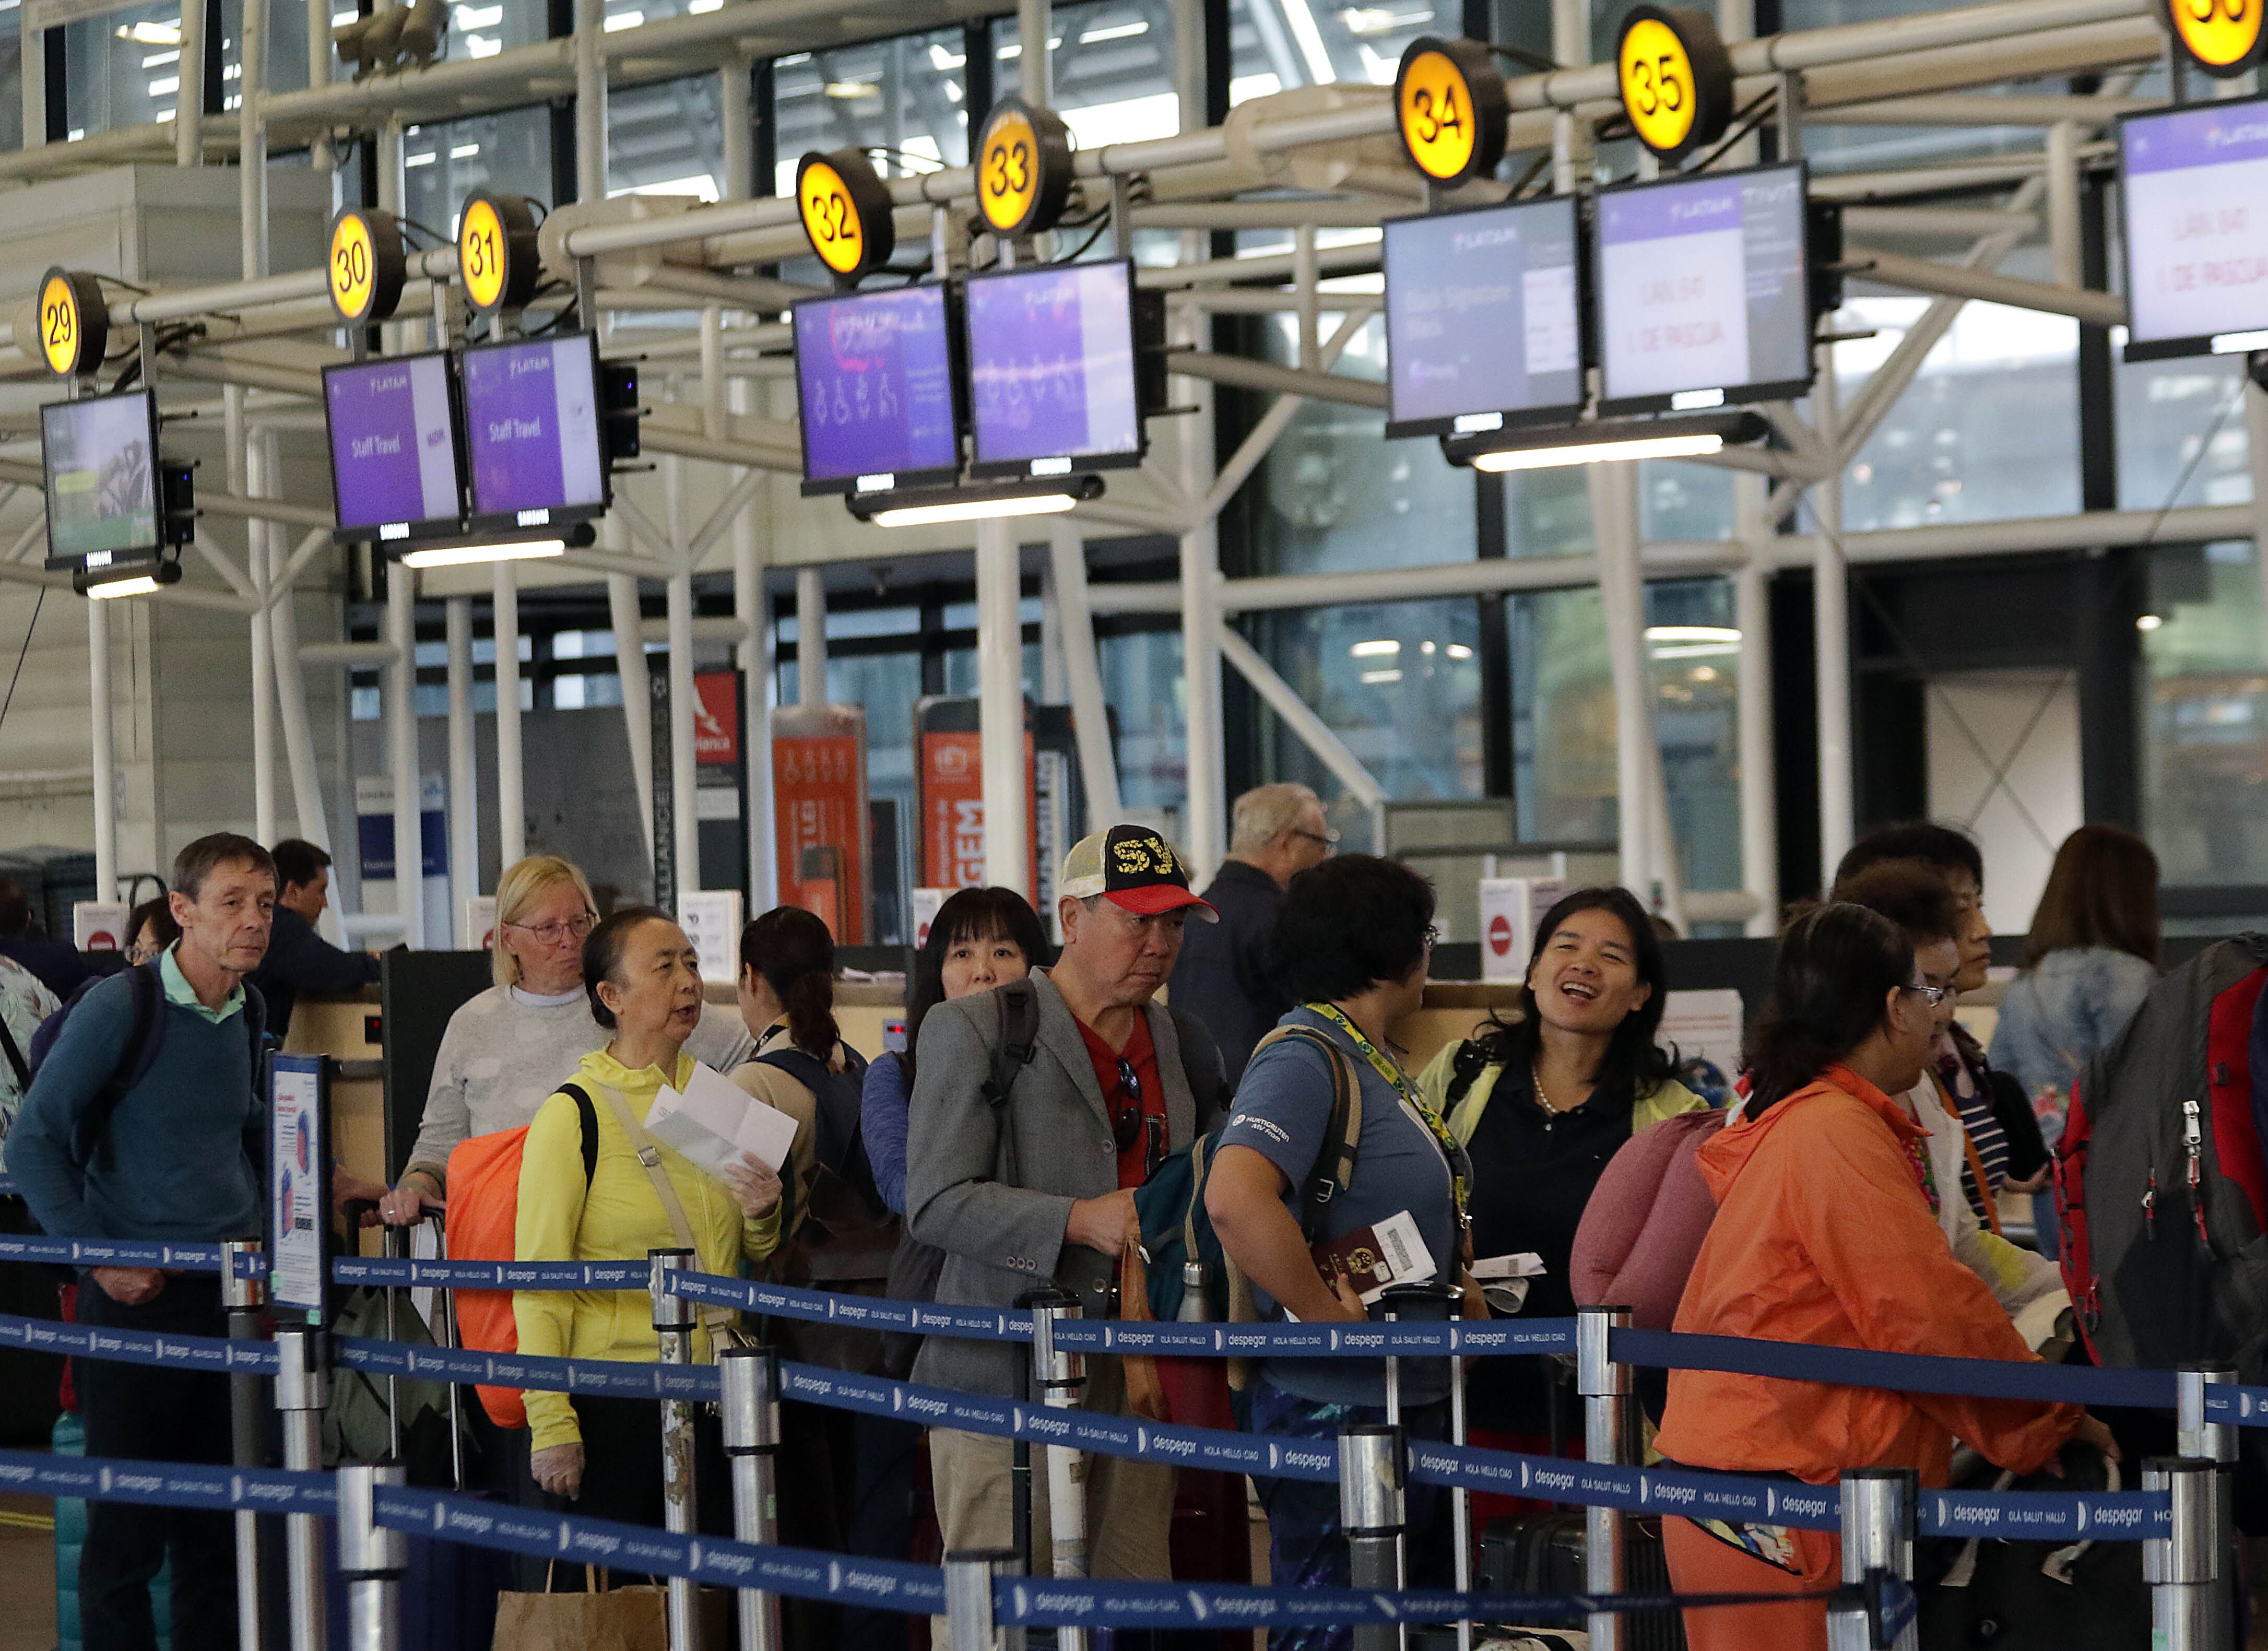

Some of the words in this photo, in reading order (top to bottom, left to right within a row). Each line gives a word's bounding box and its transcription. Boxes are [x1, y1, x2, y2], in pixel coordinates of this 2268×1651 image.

[1633, 55, 1684, 116] 35
[1413, 84, 1463, 143] 34
[990, 141, 1029, 196] 33
[813, 193, 854, 242] 32
[338, 241, 365, 292] 30
[470, 230, 494, 276] 31
[47, 301, 70, 345] 29
[352, 438, 373, 459] Staff
[375, 434, 400, 454] Travel
[489, 420, 512, 443] Staff
[513, 417, 541, 439] Travel
[595, 1270, 626, 1281] despegar
[681, 1281, 707, 1294] despegar
[758, 1293, 786, 1307] despegar
[839, 1305, 867, 1319] despegar
[922, 1313, 951, 1327] despegar
[1009, 1320, 1033, 1334] despeg
[1118, 1332, 1154, 1346] despegar
[1229, 1335, 1266, 1348] despegar
[1345, 1334, 1384, 1347] despegar
[1466, 1332, 1506, 1346] despegar
[794, 1374, 832, 1395] despegar
[907, 1395, 948, 1416] despegar
[1029, 1416, 1070, 1436] despegar
[1153, 1435, 1197, 1456] despegar
[1285, 1449, 1331, 1471] despegar
[1421, 1454, 1458, 1475] despegar
[1535, 1469, 1575, 1490] despegar
[1655, 1483, 1696, 1504] despegar
[1782, 1495, 1827, 1518] despegar
[1954, 1504, 2000, 1526] despegar
[2095, 1507, 2143, 1528] despegar
[2154, 1510, 2171, 1522] HO
